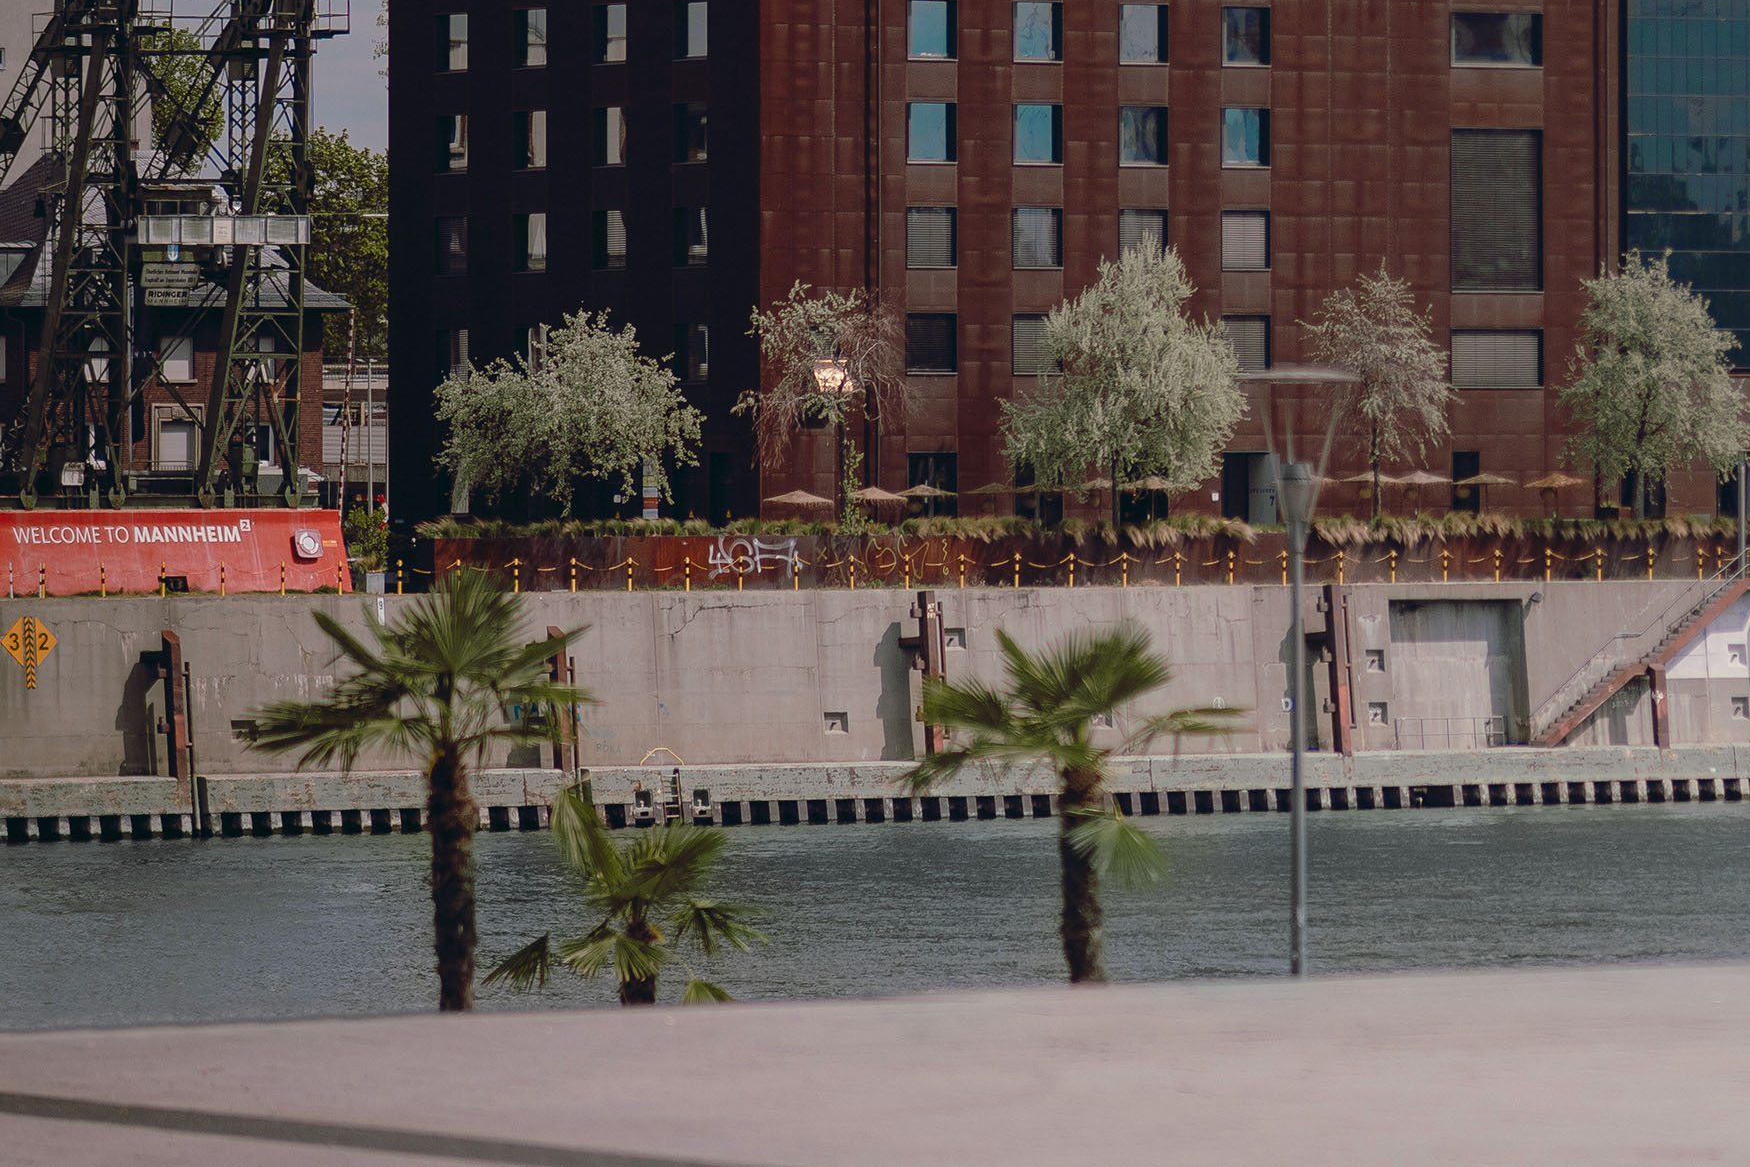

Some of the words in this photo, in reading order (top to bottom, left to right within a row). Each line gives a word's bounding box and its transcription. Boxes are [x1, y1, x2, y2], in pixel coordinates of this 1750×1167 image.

[13, 526, 101, 544] WELCOME
[104, 526, 130, 544] TO
[9, 632, 20, 651] 3
[38, 632, 49, 651] 2
